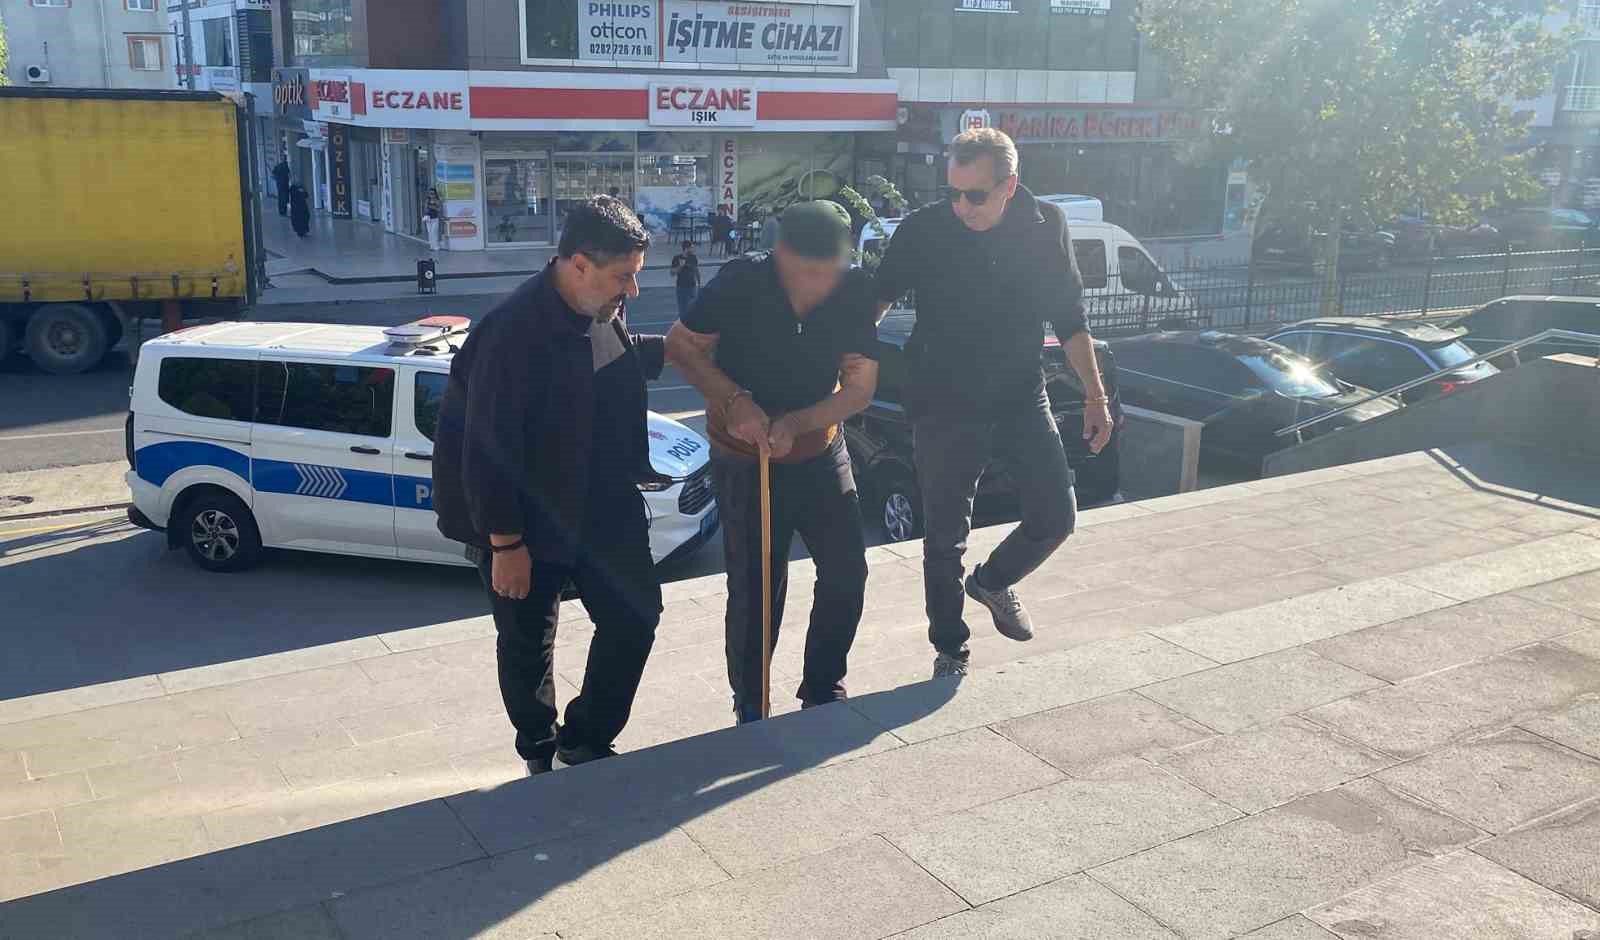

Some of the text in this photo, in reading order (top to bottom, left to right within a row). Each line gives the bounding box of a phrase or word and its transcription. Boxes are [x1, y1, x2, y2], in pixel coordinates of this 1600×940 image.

[588, 3, 650, 18] PHILIPS
[590, 22, 647, 40] oticon
[667, 12, 756, 54] İŞİTME
[274, 72, 304, 114] optik
[372, 91, 464, 110] ECZANE
[656, 87, 751, 111] ECZANE
[691, 111, 717, 123] IŞIK
[723, 139, 735, 216] ECZAN
[667, 437, 702, 462] POLİS
